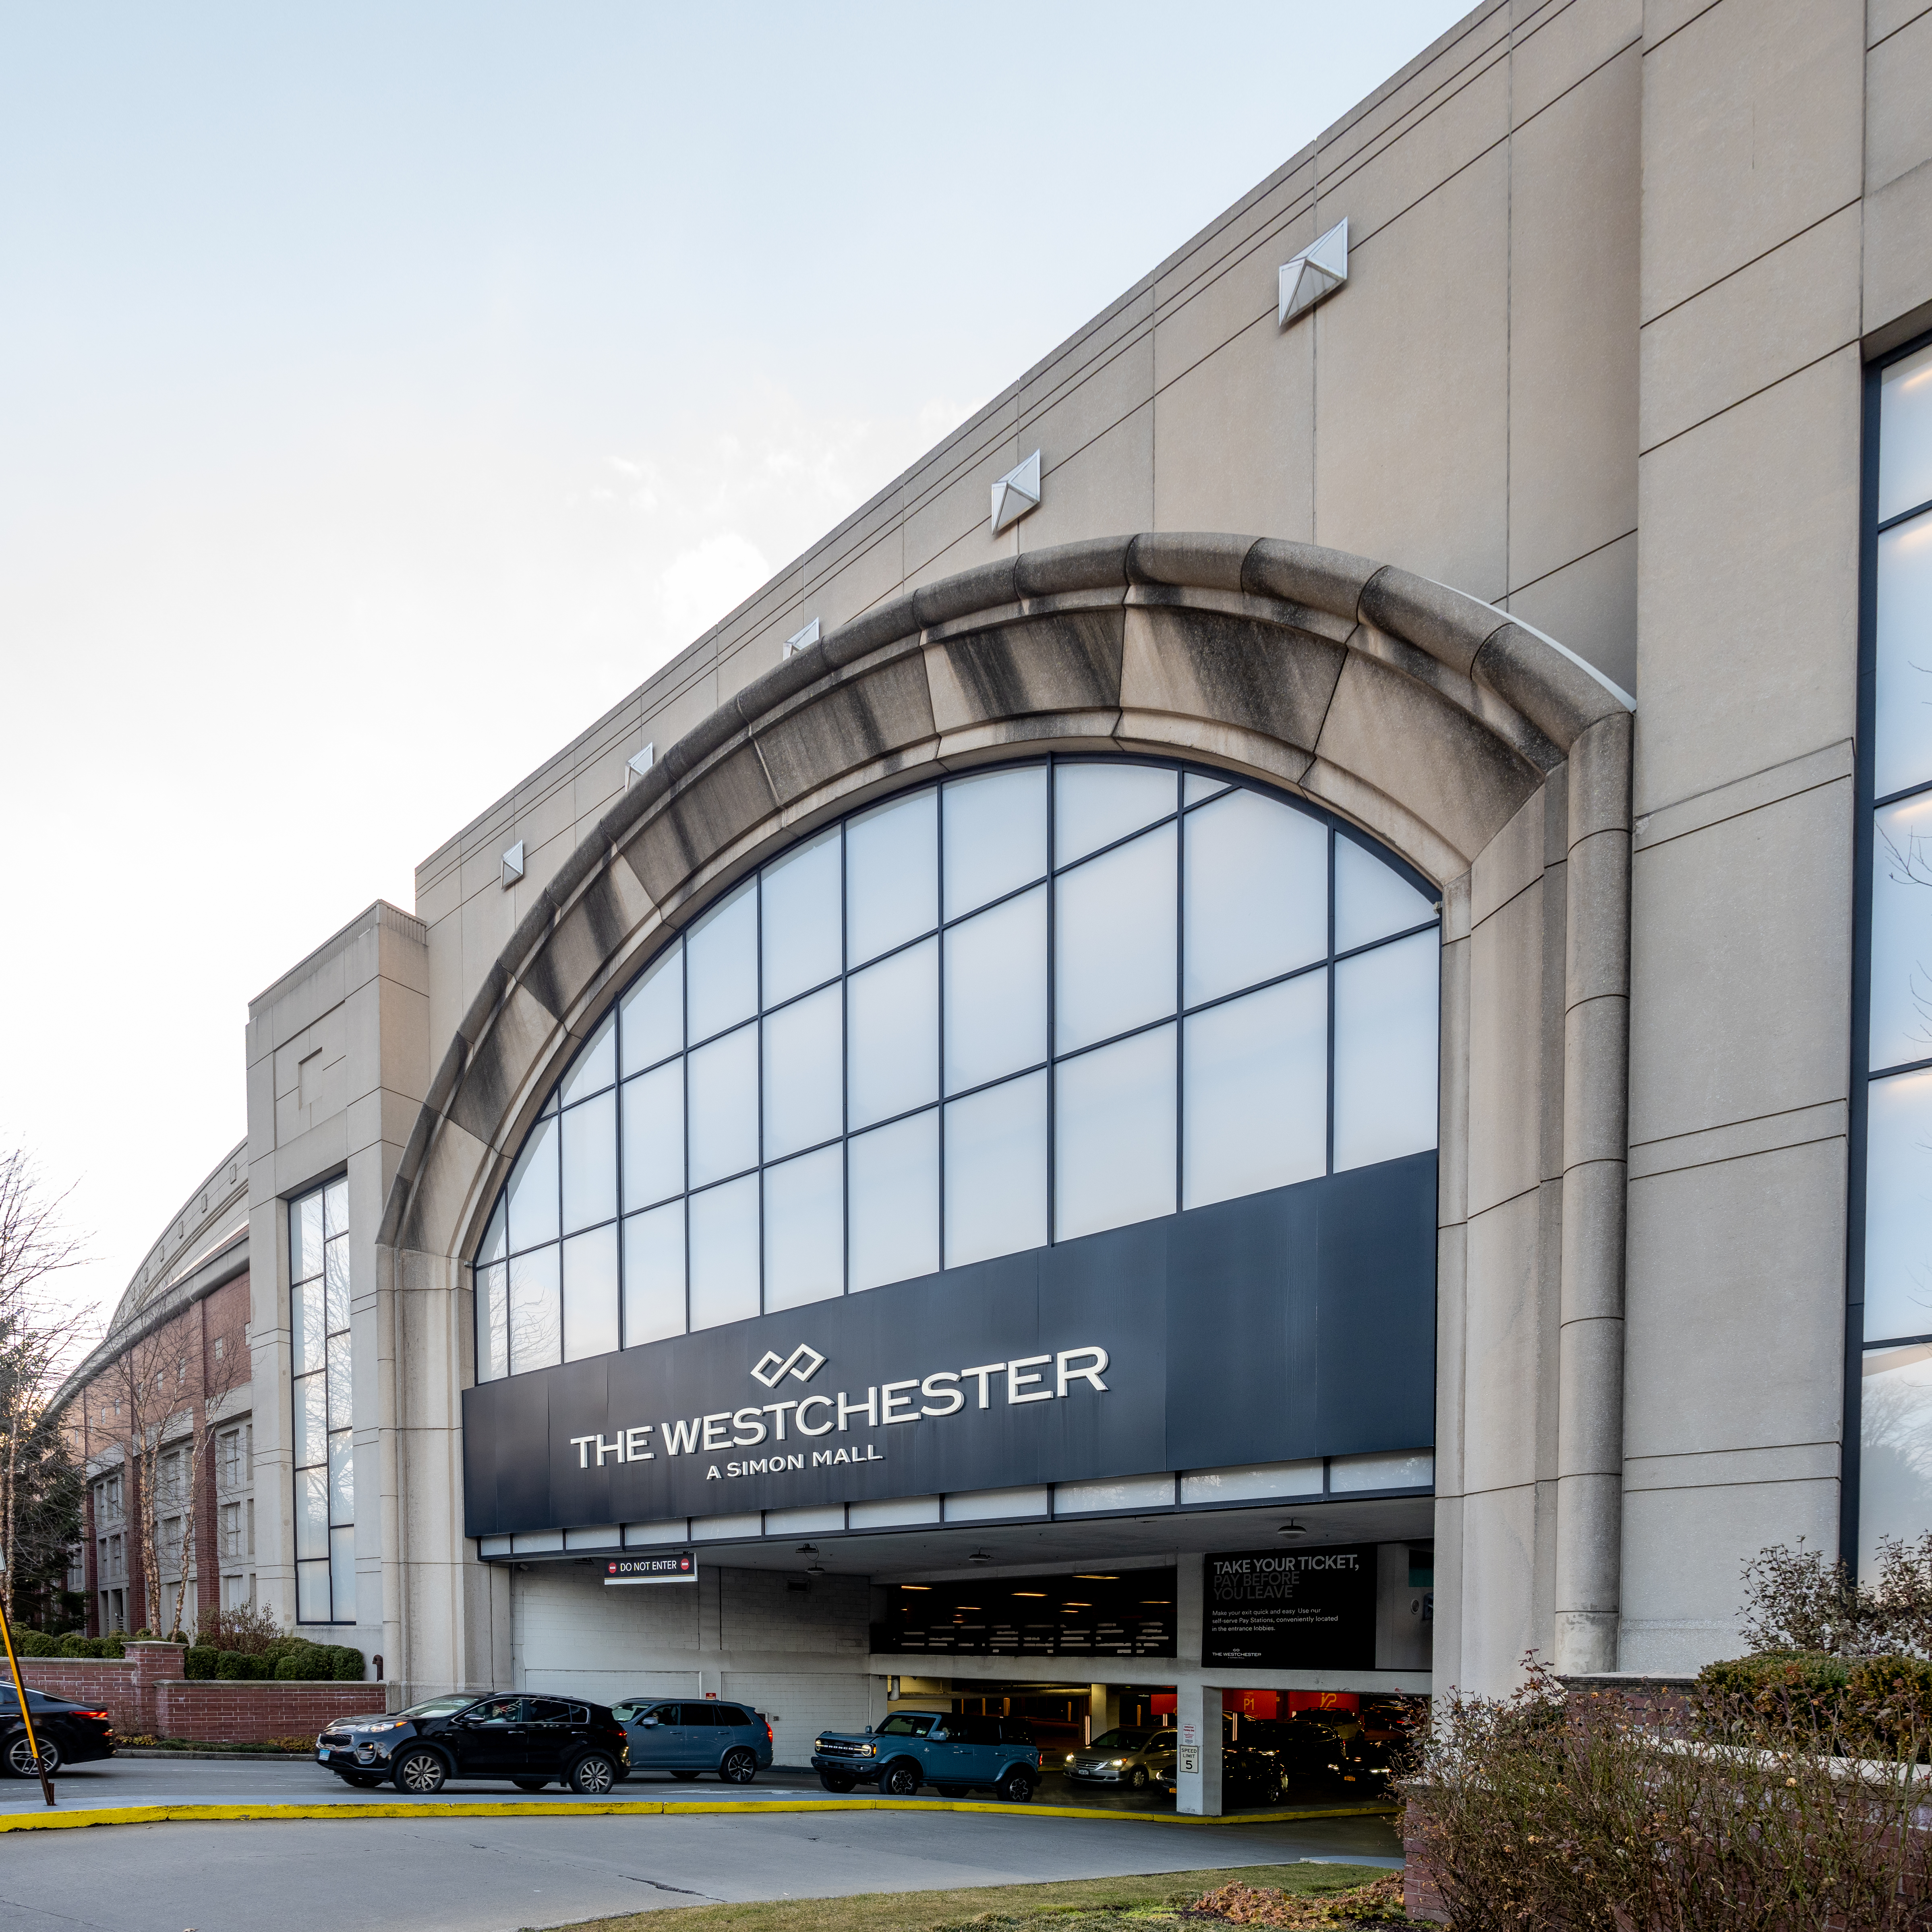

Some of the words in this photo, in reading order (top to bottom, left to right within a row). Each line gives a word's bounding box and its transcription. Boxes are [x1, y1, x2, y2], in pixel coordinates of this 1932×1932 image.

[570, 1425, 654, 1468] THE
[661, 1346, 1109, 1456] WESTCHESTER
[706, 1465, 722, 1480] A
[727, 1454, 804, 1477] SIMON
[813, 1444, 883, 1467] MALL
[620, 1563, 632, 1572] DO
[634, 1562, 650, 1571] NOT
[652, 1560, 677, 1570] ENTER
[1213, 1560, 1251, 1574] TAKE
[1253, 1558, 1295, 1572] YOUR
[1298, 1555, 1359, 1571] TICKET,
[1214, 1574, 1240, 1587] PAY
[1243, 1571, 1300, 1586] BEFORE
[1213, 1587, 1243, 1600] YOU
[1247, 1585, 1293, 1599] LEAVE
[1244, 1698, 1254, 1710] P1
[1185, 1760, 1193, 1770] 5
